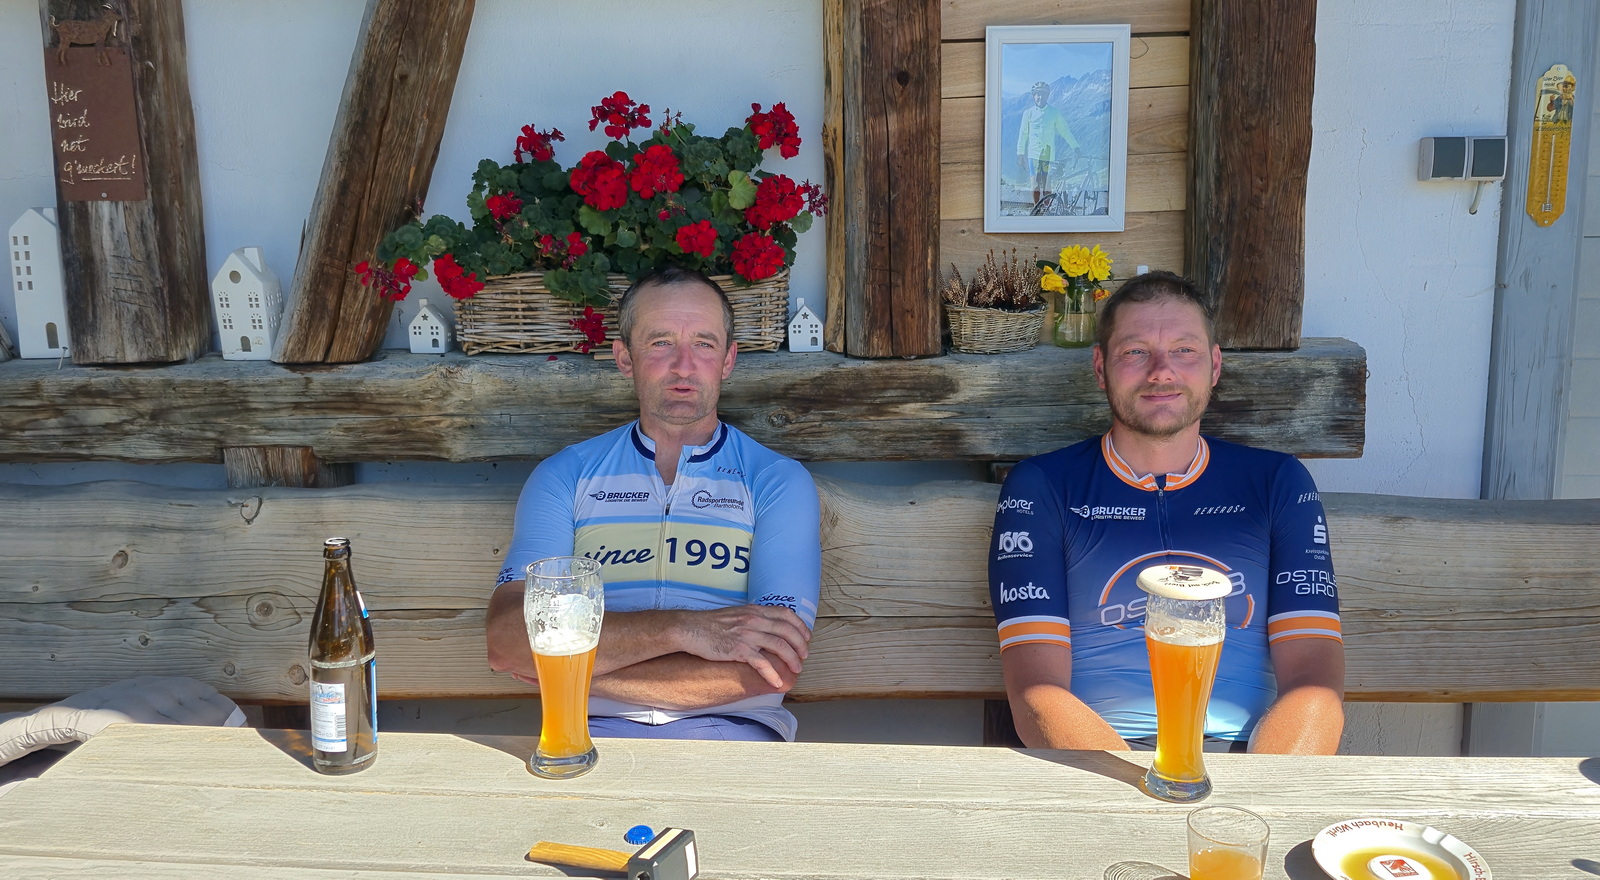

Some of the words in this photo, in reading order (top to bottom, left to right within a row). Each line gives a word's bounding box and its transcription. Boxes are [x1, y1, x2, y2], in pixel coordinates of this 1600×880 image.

[51, 81, 82, 106] Hier
[996, 496, 1034, 514] xplorer
[1091, 506, 1146, 516] BRUCKER
[666, 537, 750, 574] 1995
[759, 593, 796, 603] since
[1000, 582, 1050, 604] hosta
[1295, 583, 1335, 598] GIRO
[1351, 820, 1404, 832] Heubach
